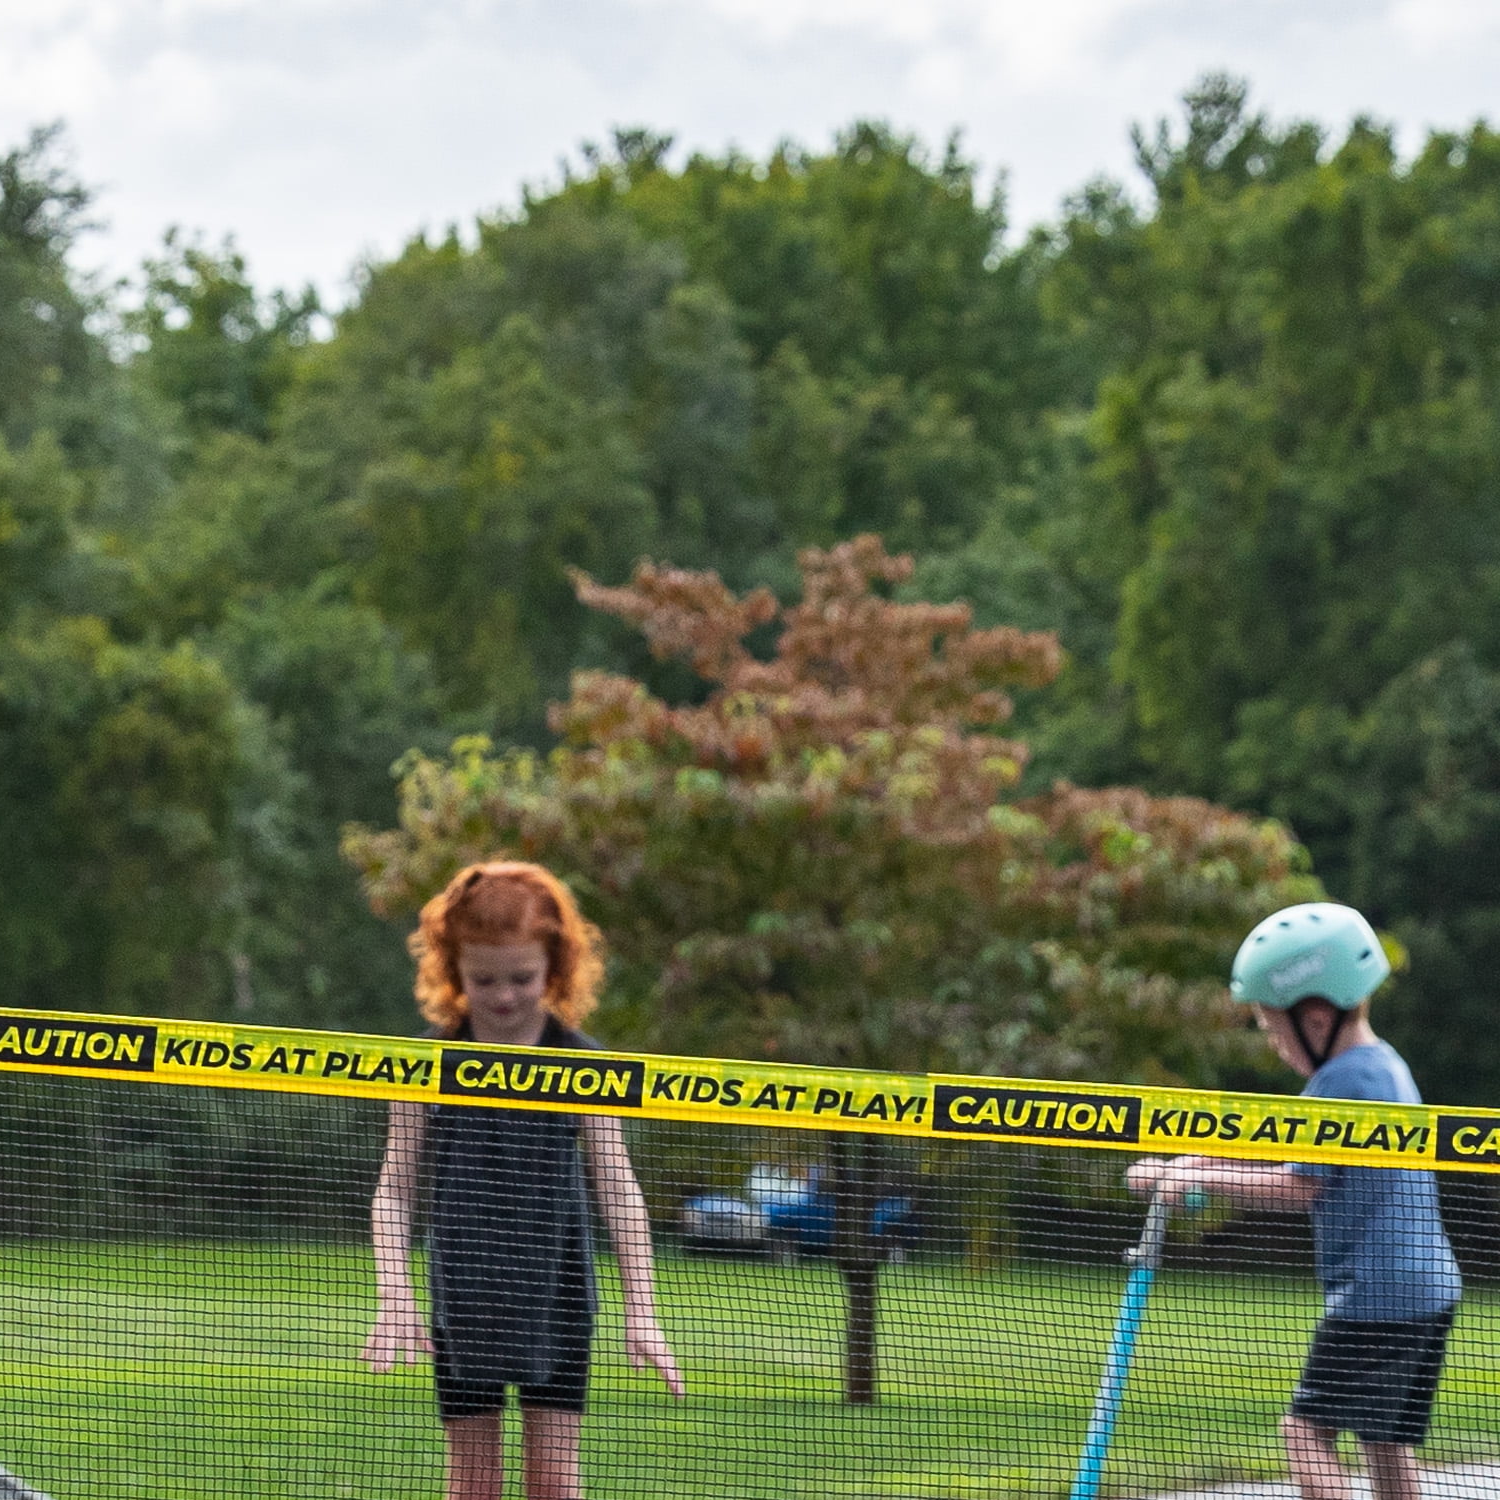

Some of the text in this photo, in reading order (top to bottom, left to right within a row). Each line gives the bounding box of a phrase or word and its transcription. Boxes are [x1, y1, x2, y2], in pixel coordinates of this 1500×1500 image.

[162, 1038, 253, 1071] KIDS
[260, 1047, 316, 1074] AT
[321, 1053, 434, 1087] PLAY!
[455, 1059, 633, 1098] CAUTION
[650, 1073, 745, 1106] KIDS
[751, 1084, 808, 1112] AT
[813, 1089, 928, 1124] PLAY!
[948, 1096, 1129, 1134] CAUTION
[1148, 1109, 1242, 1142] KIDS
[1250, 1116, 1310, 1144] AT
[1314, 1119, 1431, 1154] PLAY!
